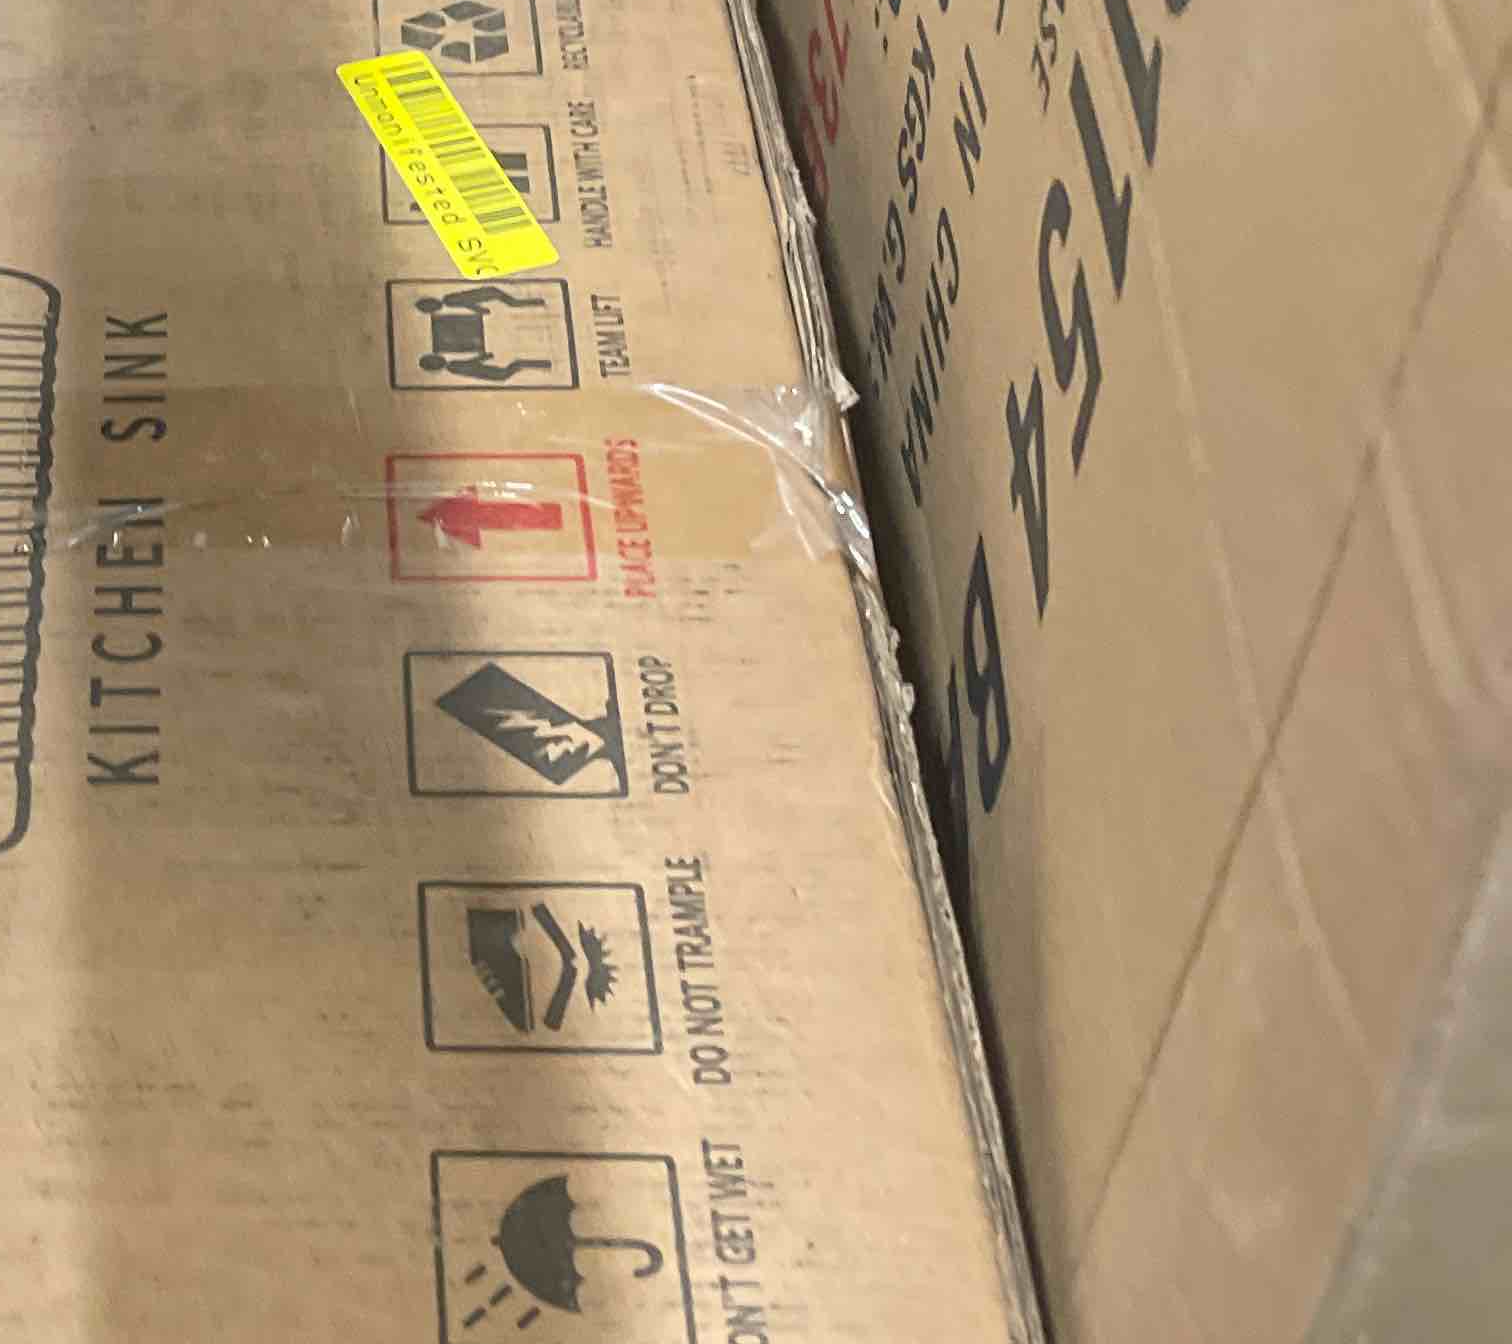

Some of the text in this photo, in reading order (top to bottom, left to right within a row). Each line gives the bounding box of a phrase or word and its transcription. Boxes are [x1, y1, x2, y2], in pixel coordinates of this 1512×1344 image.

[896, 17, 936, 215] KGS
[951, 46, 988, 195] IN
[579, 183, 613, 249] HANDLE
[590, 293, 631, 379] TEAM LIFT
[900, 208, 961, 509] CHINA
[87, 311, 168, 786] KITCHEN SINK
[603, 437, 657, 599] PLACE UPWARDS
[637, 655, 691, 796] DON'T DROP
[664, 854, 732, 1087] DO NOT TRAMPLE
[701, 1139, 748, 1203] WET
[710, 1210, 758, 1267] GET
